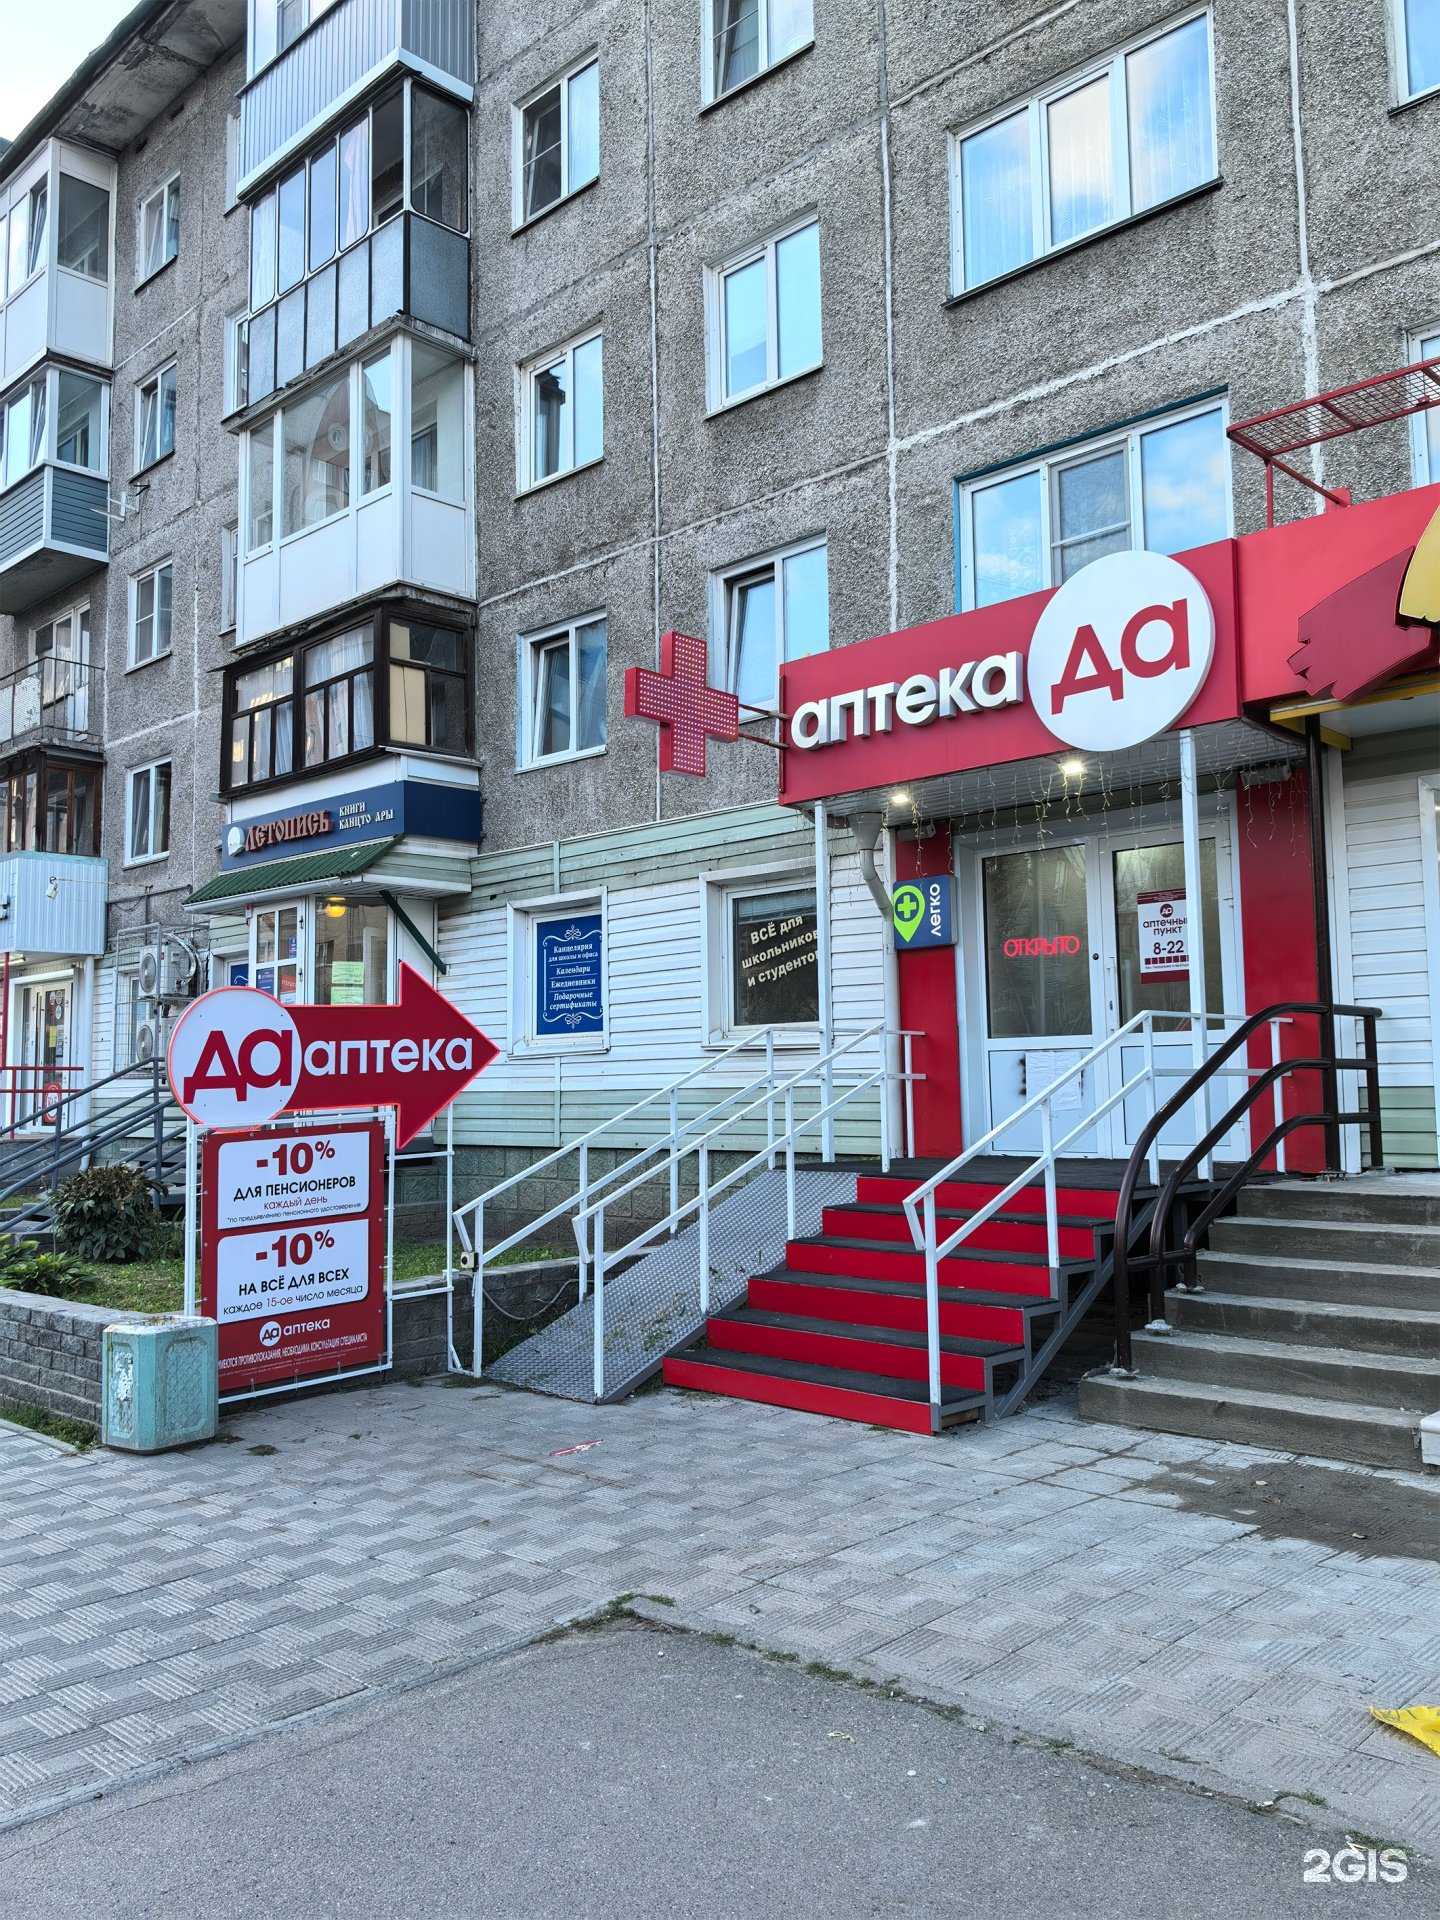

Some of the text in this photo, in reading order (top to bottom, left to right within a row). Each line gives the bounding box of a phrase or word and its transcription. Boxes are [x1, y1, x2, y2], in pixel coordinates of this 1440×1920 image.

[790, 651, 1023, 751] аптека
[339, 801, 366, 817] КНИГИ
[245, 810, 332, 851] ЛЕТОПИСЬ
[750, 916, 803, 944] ВСЁ для
[1153, 926, 1182, 936] пункт
[553, 943, 593, 954] Канцелярия
[1004, 935, 1081, 958] ОТКРЫТО
[1153, 940, 1184, 955] 8-22
[556, 965, 591, 976] Календари
[747, 951, 818, 987] и студенто
[551, 978, 596, 988] Ежедневники
[549, 1000, 598, 1011] сертификаты
[553, 991, 593, 1001] Подарочные
[303, 1037, 473, 1076] аптека
[256, 1140, 335, 1176] -10%
[233, 1175, 356, 1202] ДЛЯ ПЕНСИОНЕРОВ
[263, 1196, 328, 1210] каждый день
[255, 1229, 335, 1267] -10%
[238, 1268, 350, 1296] НА ВСЁ ДЛЯ ВСЕХ
[223, 1285, 363, 1315] каждое 15-ое число месяца
[283, 1318, 331, 1336] аптека
